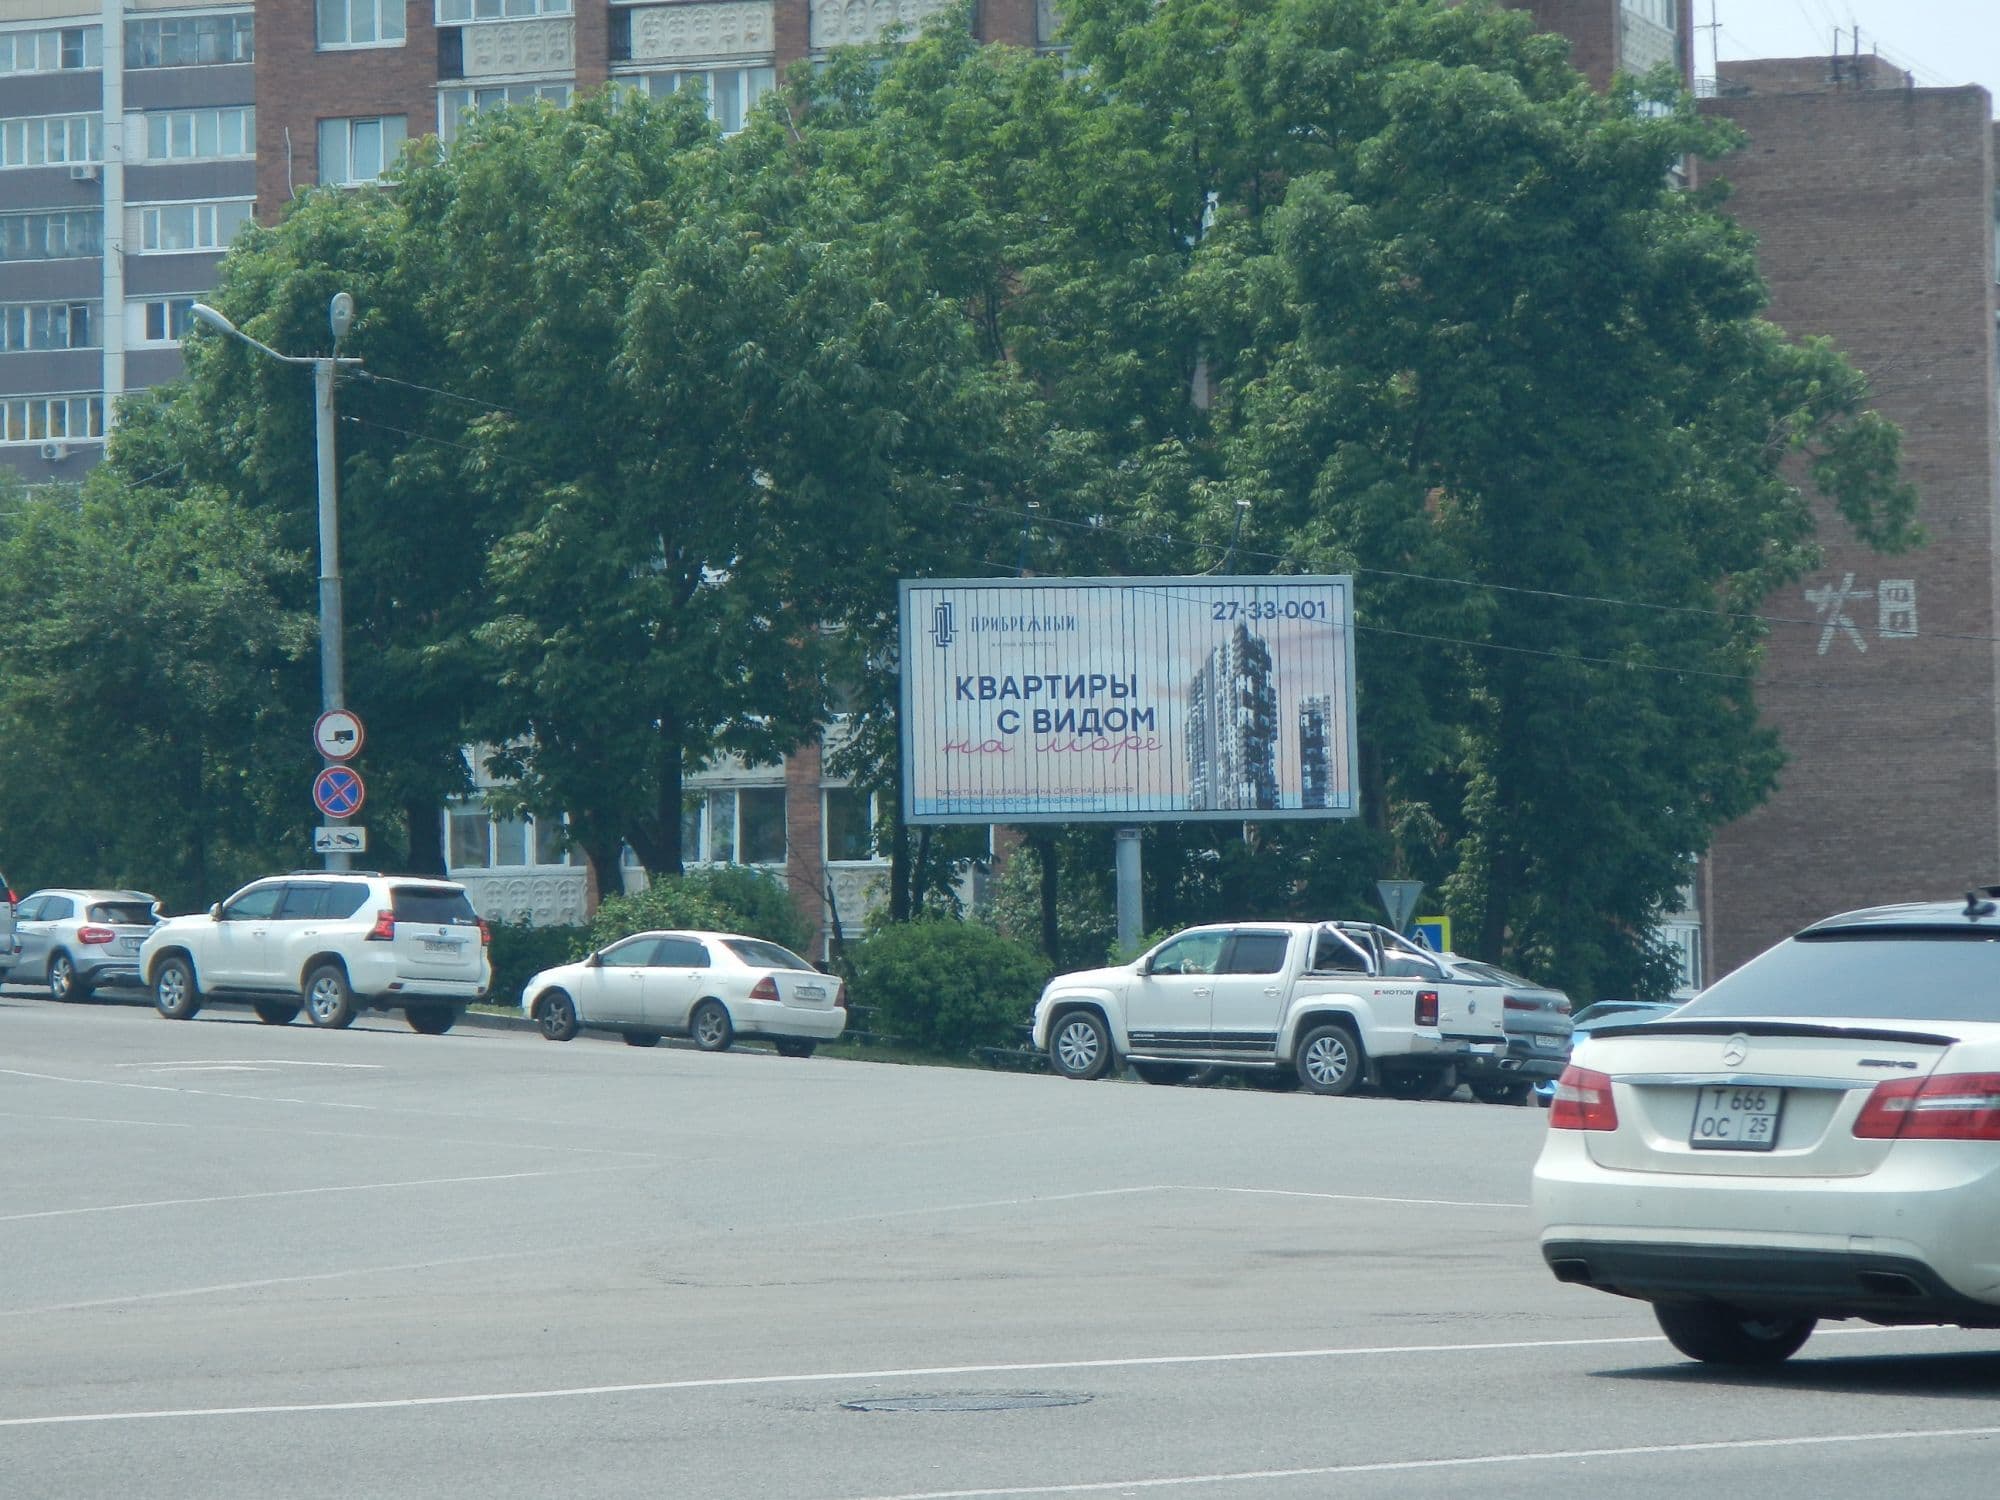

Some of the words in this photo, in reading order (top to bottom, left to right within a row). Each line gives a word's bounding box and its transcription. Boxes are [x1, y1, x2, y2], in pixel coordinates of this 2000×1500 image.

[970, 614, 1076, 632] ПРИБРЕЖНЫЙ
[955, 673, 1137, 701] КВАРТИРЫ
[996, 709, 1020, 735] С
[1032, 707, 1155, 737] ВИДОМ
[942, 739, 1014, 754] на
[1034, 735, 1164, 764] море
[1731, 1087, 1766, 1111] 666
[1748, 1117, 1769, 1133] 25
